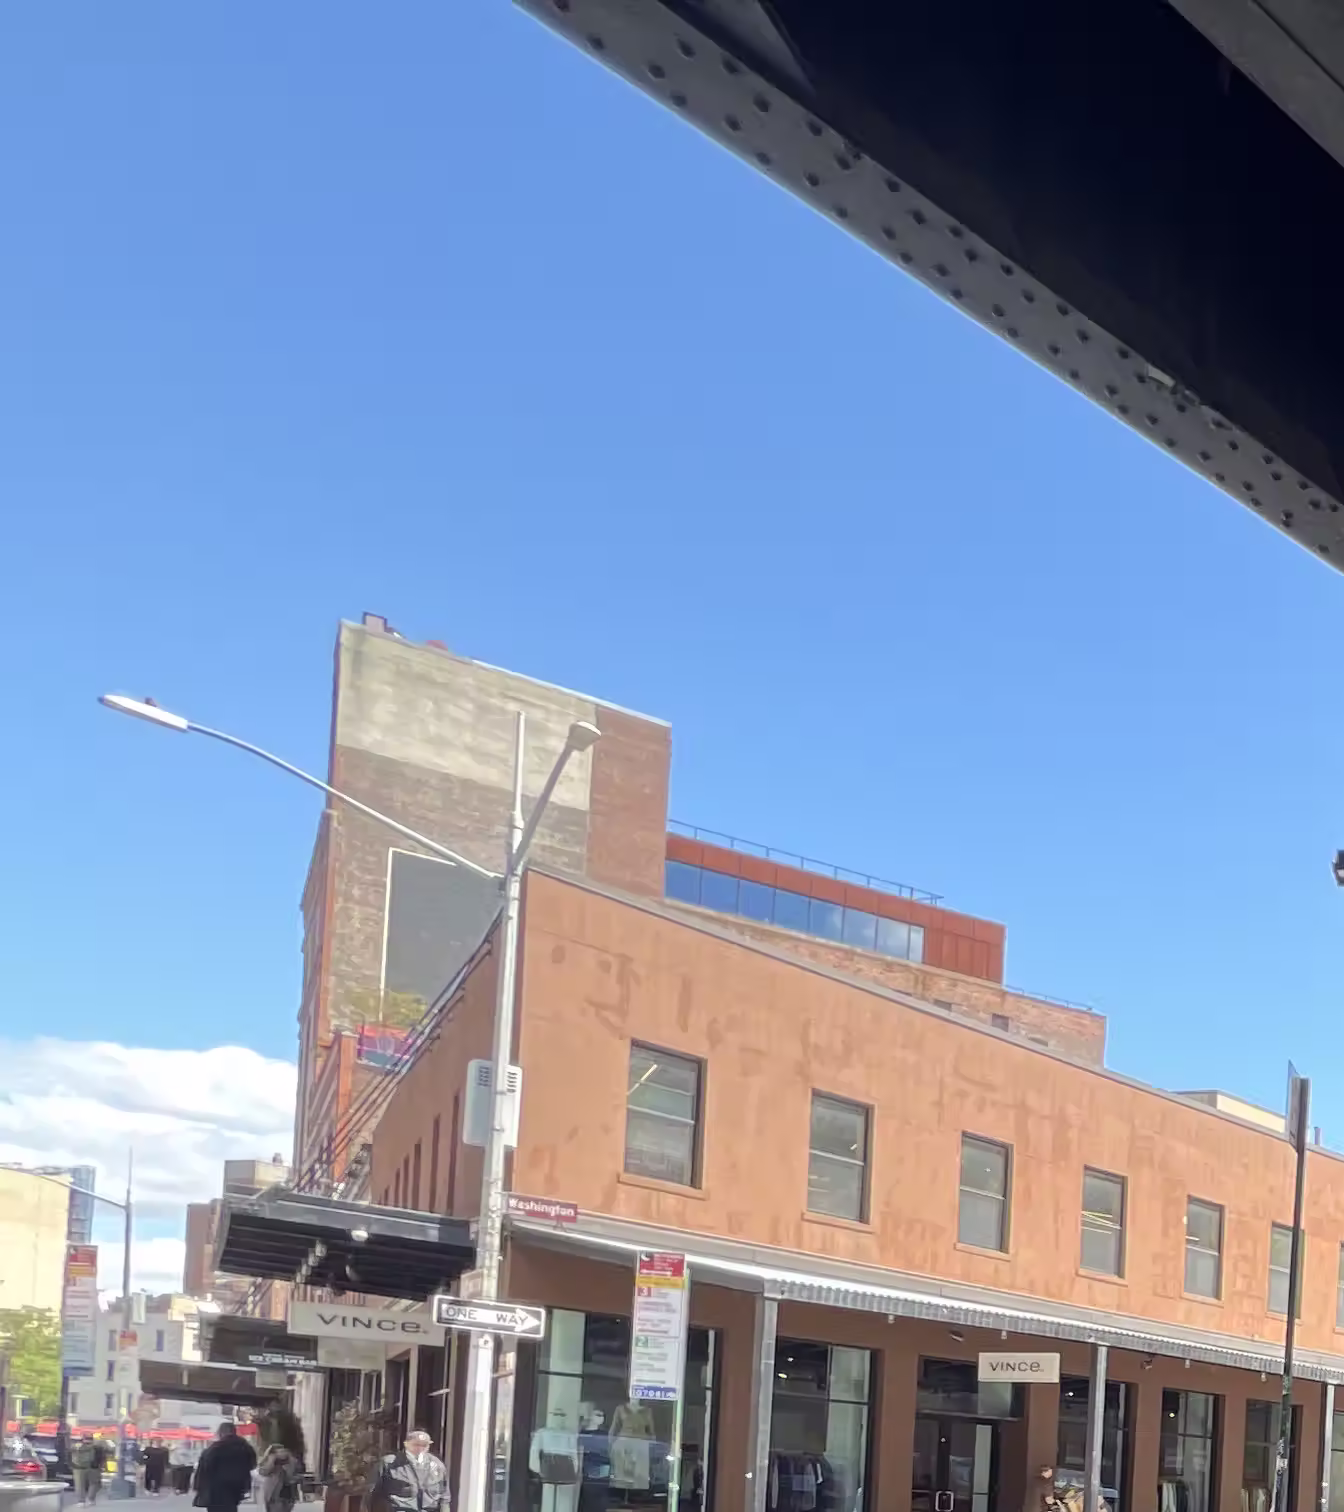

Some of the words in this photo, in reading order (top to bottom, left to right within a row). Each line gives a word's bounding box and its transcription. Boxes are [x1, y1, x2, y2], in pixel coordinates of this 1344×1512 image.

[508, 1197, 576, 1217] Washington
[446, 1306, 478, 1320] ONE
[495, 1312, 529, 1327] WAY
